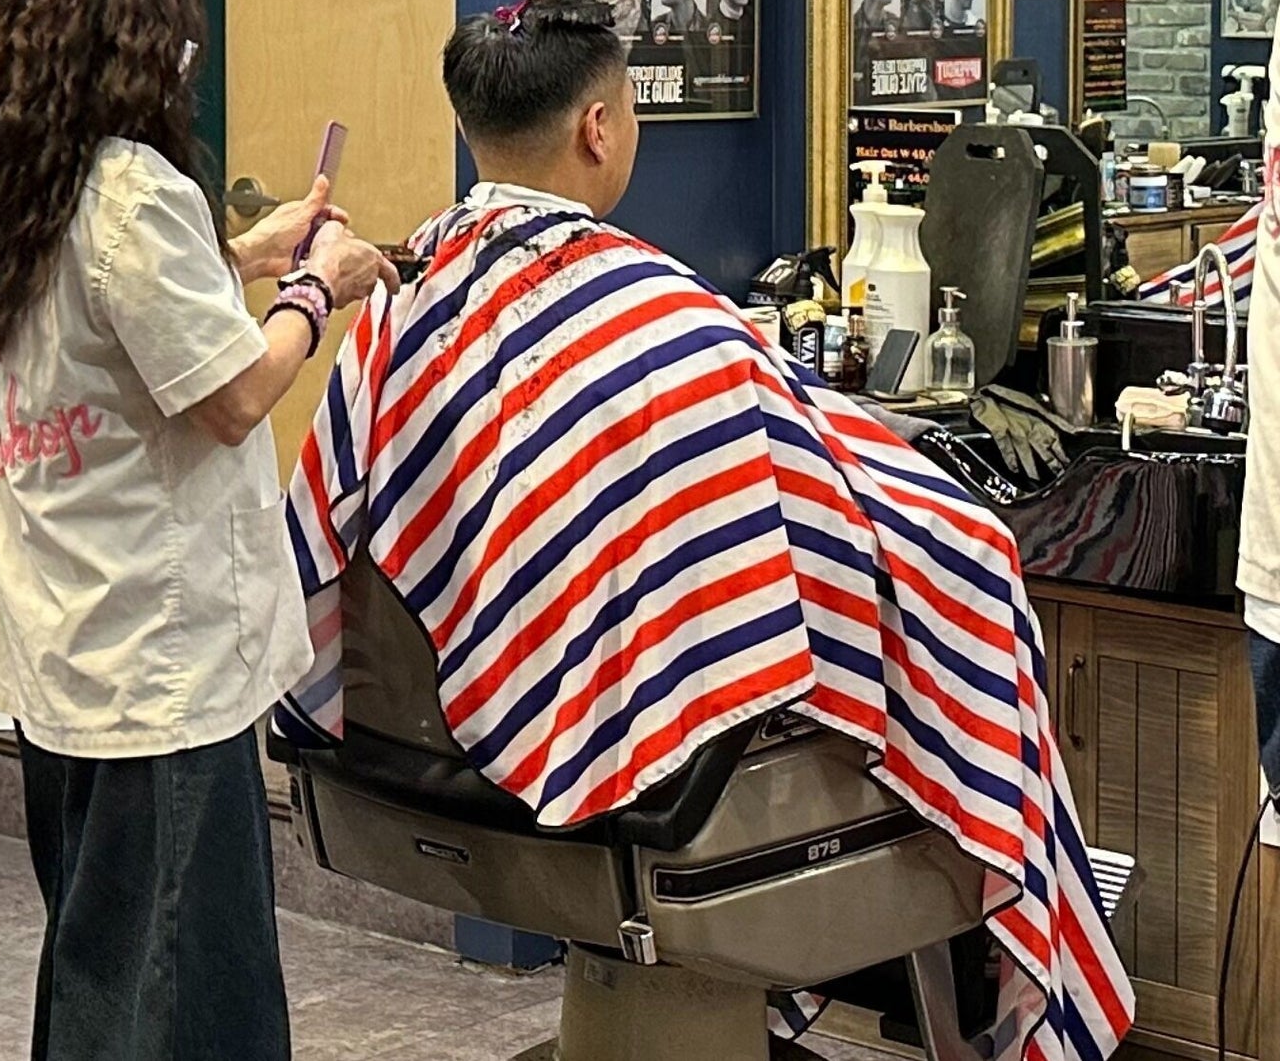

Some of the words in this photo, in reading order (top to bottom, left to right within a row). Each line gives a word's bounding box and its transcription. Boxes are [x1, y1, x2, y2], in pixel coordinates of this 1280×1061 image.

[652, 81, 684, 104] GUIDE
[856, 146, 880, 158] Hair
[807, 838, 841, 861] 879
